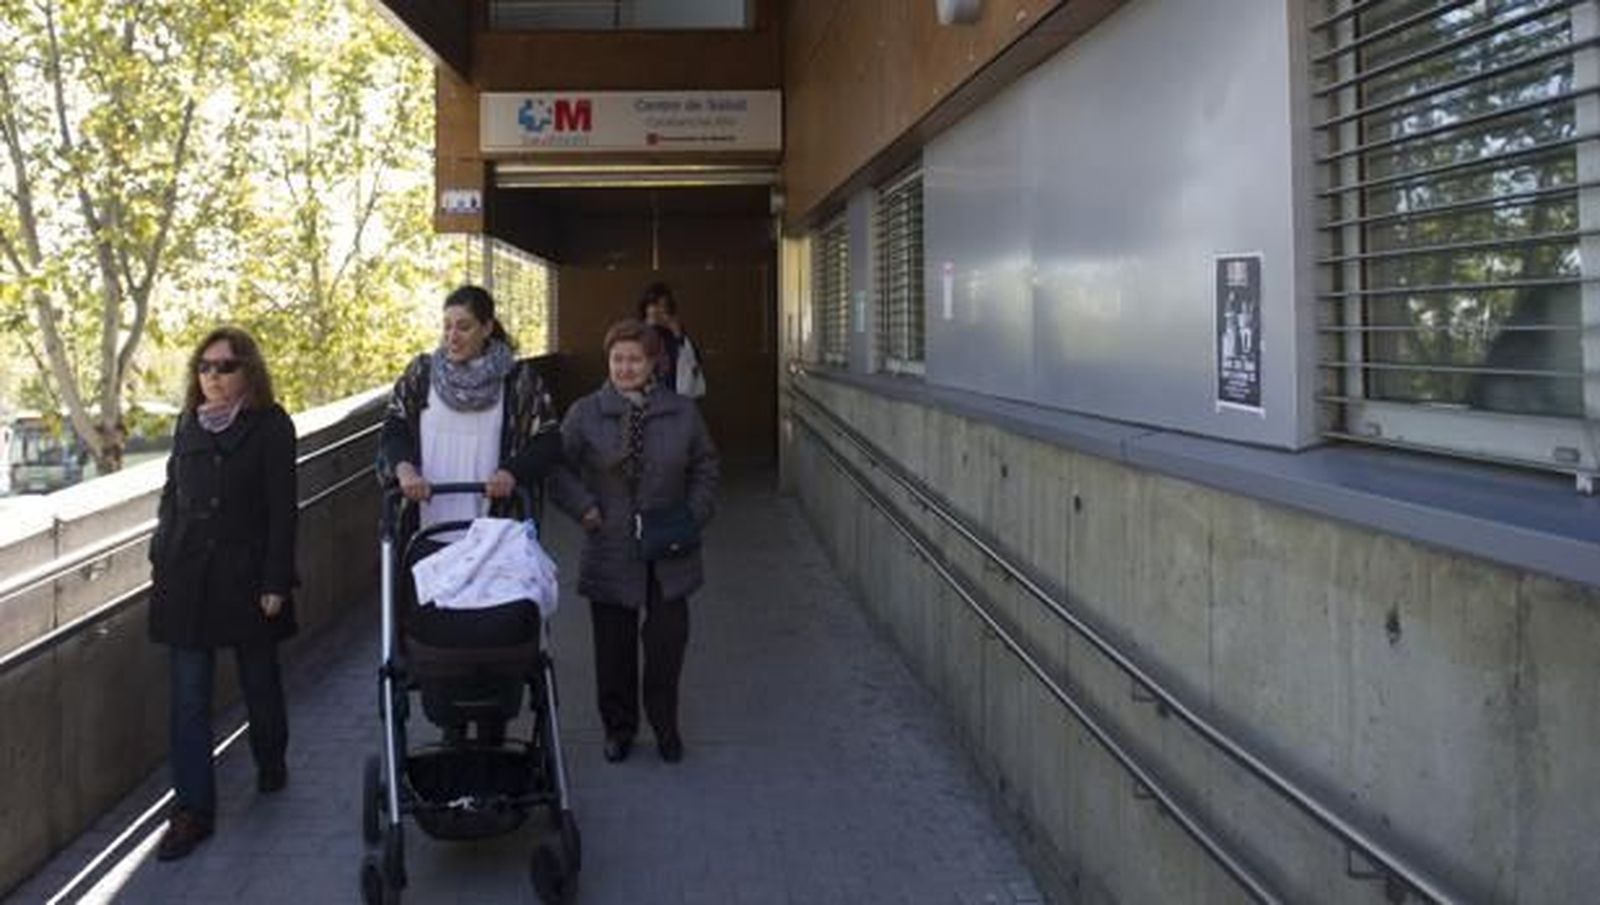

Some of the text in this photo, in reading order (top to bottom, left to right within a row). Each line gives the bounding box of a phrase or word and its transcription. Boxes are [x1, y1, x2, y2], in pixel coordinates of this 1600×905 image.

[554, 100, 592, 131] M
[634, 98, 680, 112] Centro
[684, 99, 702, 112] de
